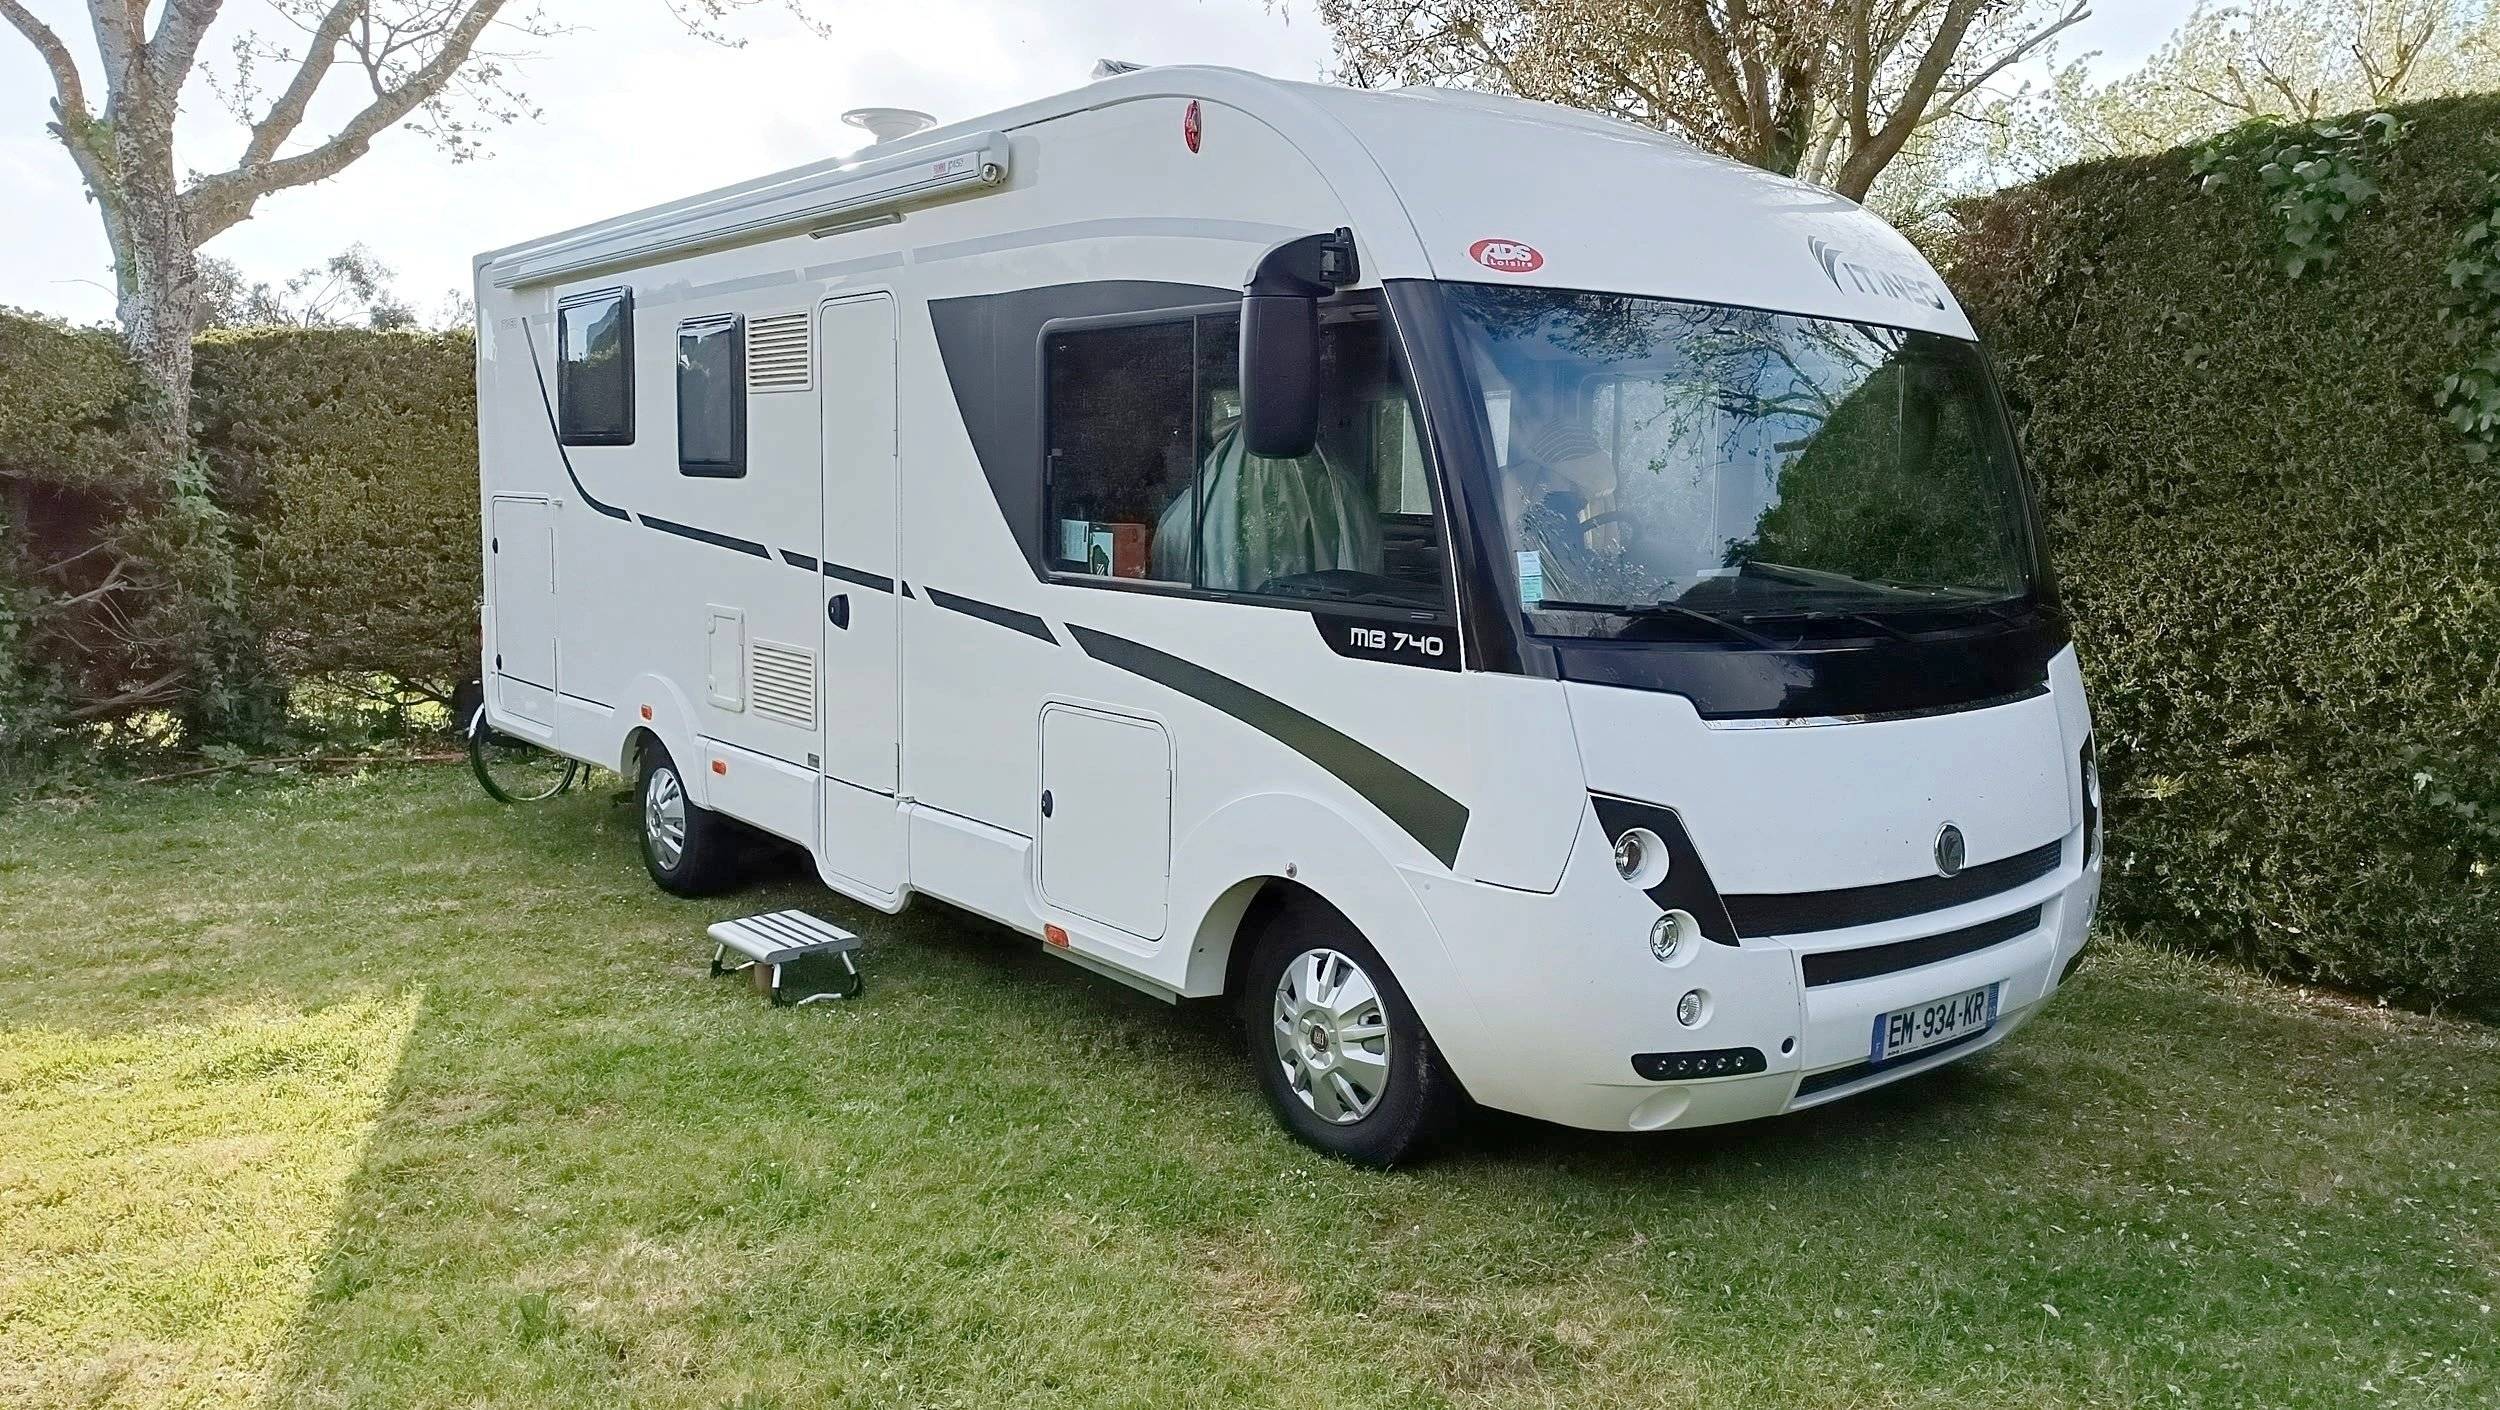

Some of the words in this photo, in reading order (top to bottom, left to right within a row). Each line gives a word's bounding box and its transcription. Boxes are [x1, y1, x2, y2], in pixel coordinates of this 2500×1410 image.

[1481, 243, 1532, 264] ADS
[1842, 262, 1946, 311] ITINEO
[1350, 627, 1386, 649] MB
[1392, 632, 1443, 656] 740
[1888, 991, 1984, 1048] EM-934-KR
